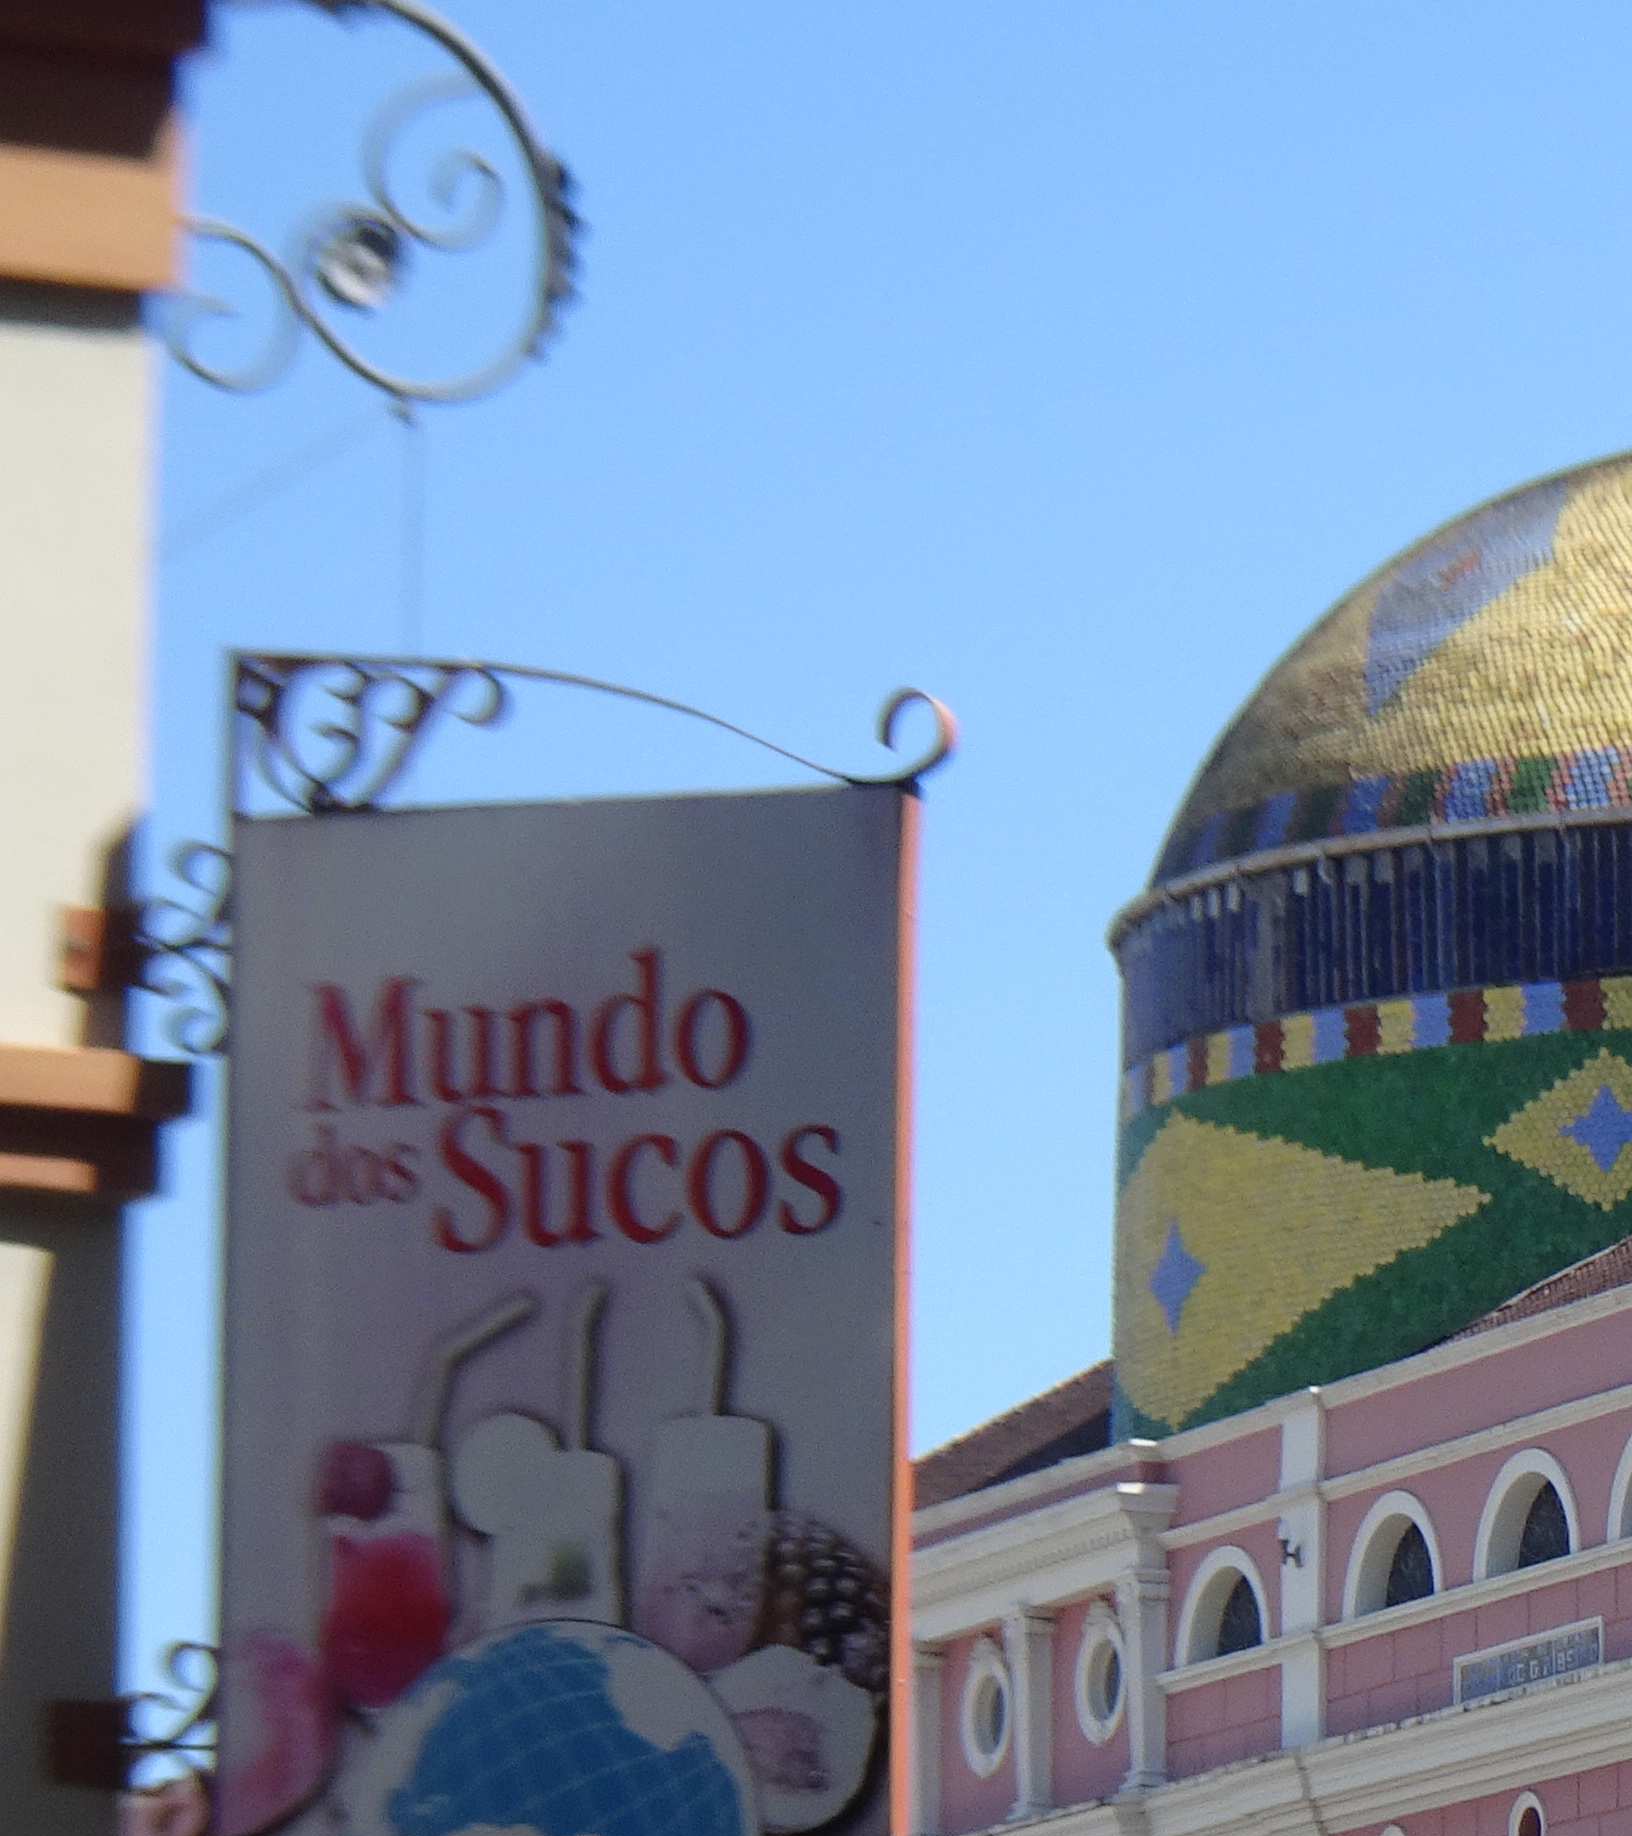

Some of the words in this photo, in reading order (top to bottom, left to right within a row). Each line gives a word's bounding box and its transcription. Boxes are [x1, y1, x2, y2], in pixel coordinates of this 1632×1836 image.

[301, 945, 752, 1110] Mundo
[287, 1121, 418, 1206] dos
[433, 1106, 844, 1254] Sucos
